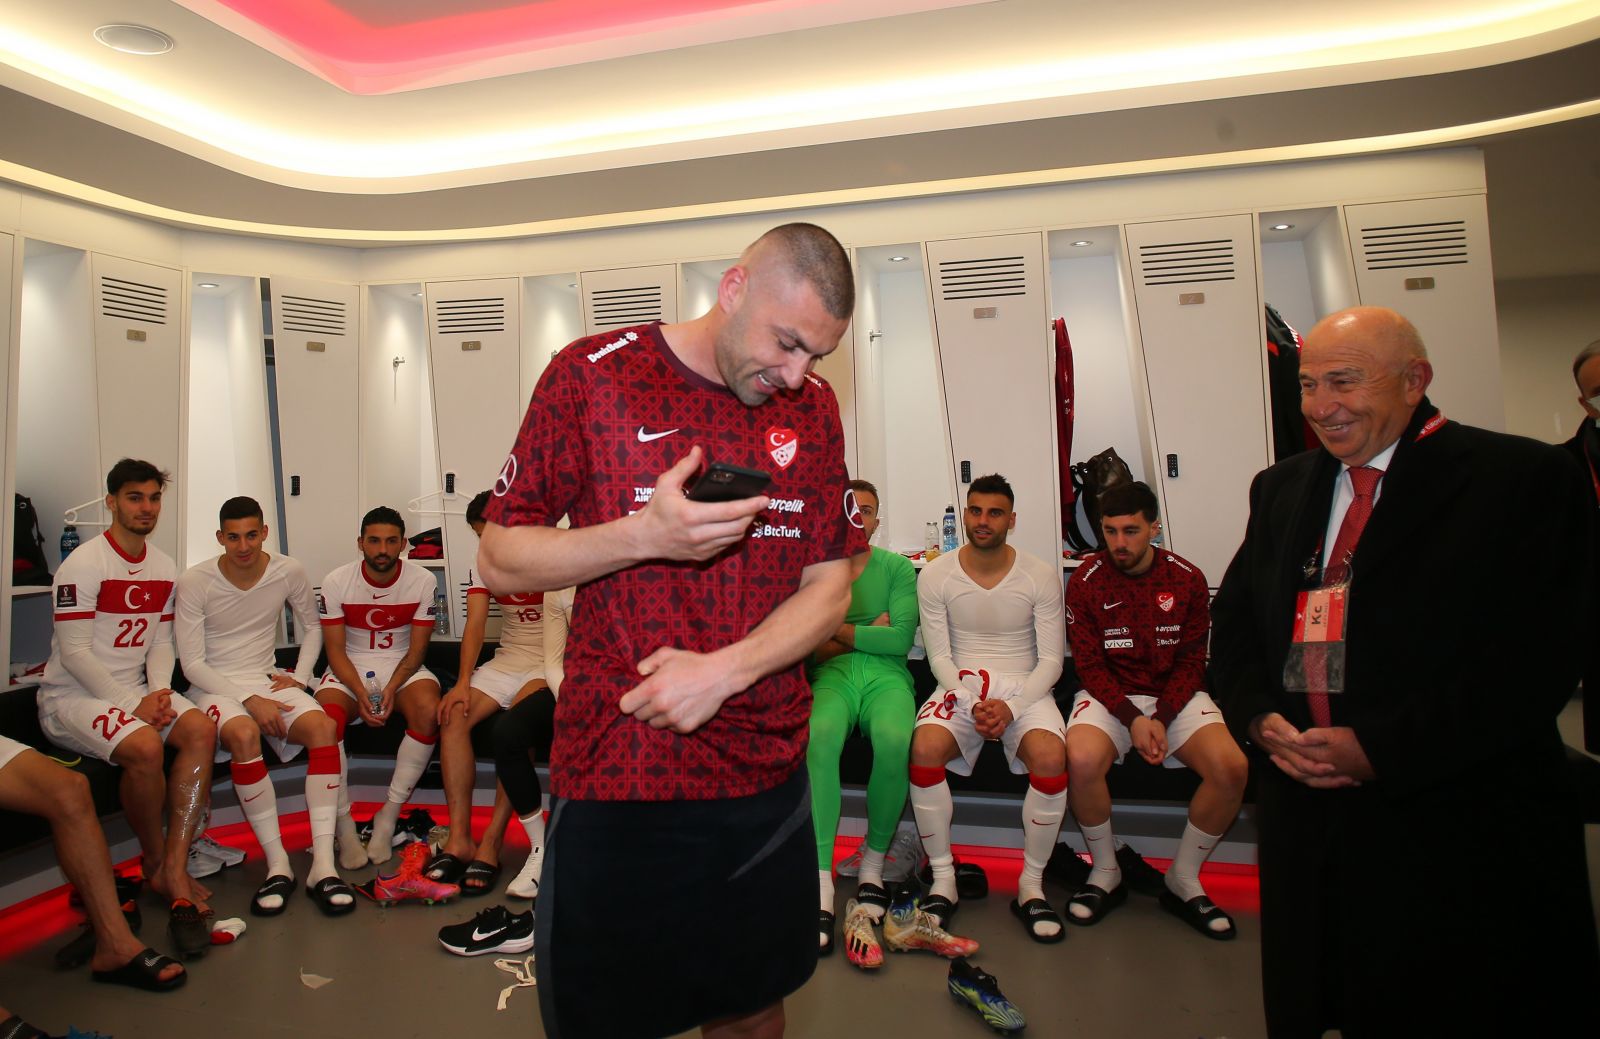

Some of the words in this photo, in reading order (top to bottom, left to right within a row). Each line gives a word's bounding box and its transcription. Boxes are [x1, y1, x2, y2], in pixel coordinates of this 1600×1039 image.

[587, 338, 630, 363] DenizBank
[764, 525, 801, 538] BtcTurk
[1311, 605, 1322, 625] Kc
[113, 618, 148, 648] 22
[369, 631, 393, 650] 13
[92, 707, 138, 742] 22
